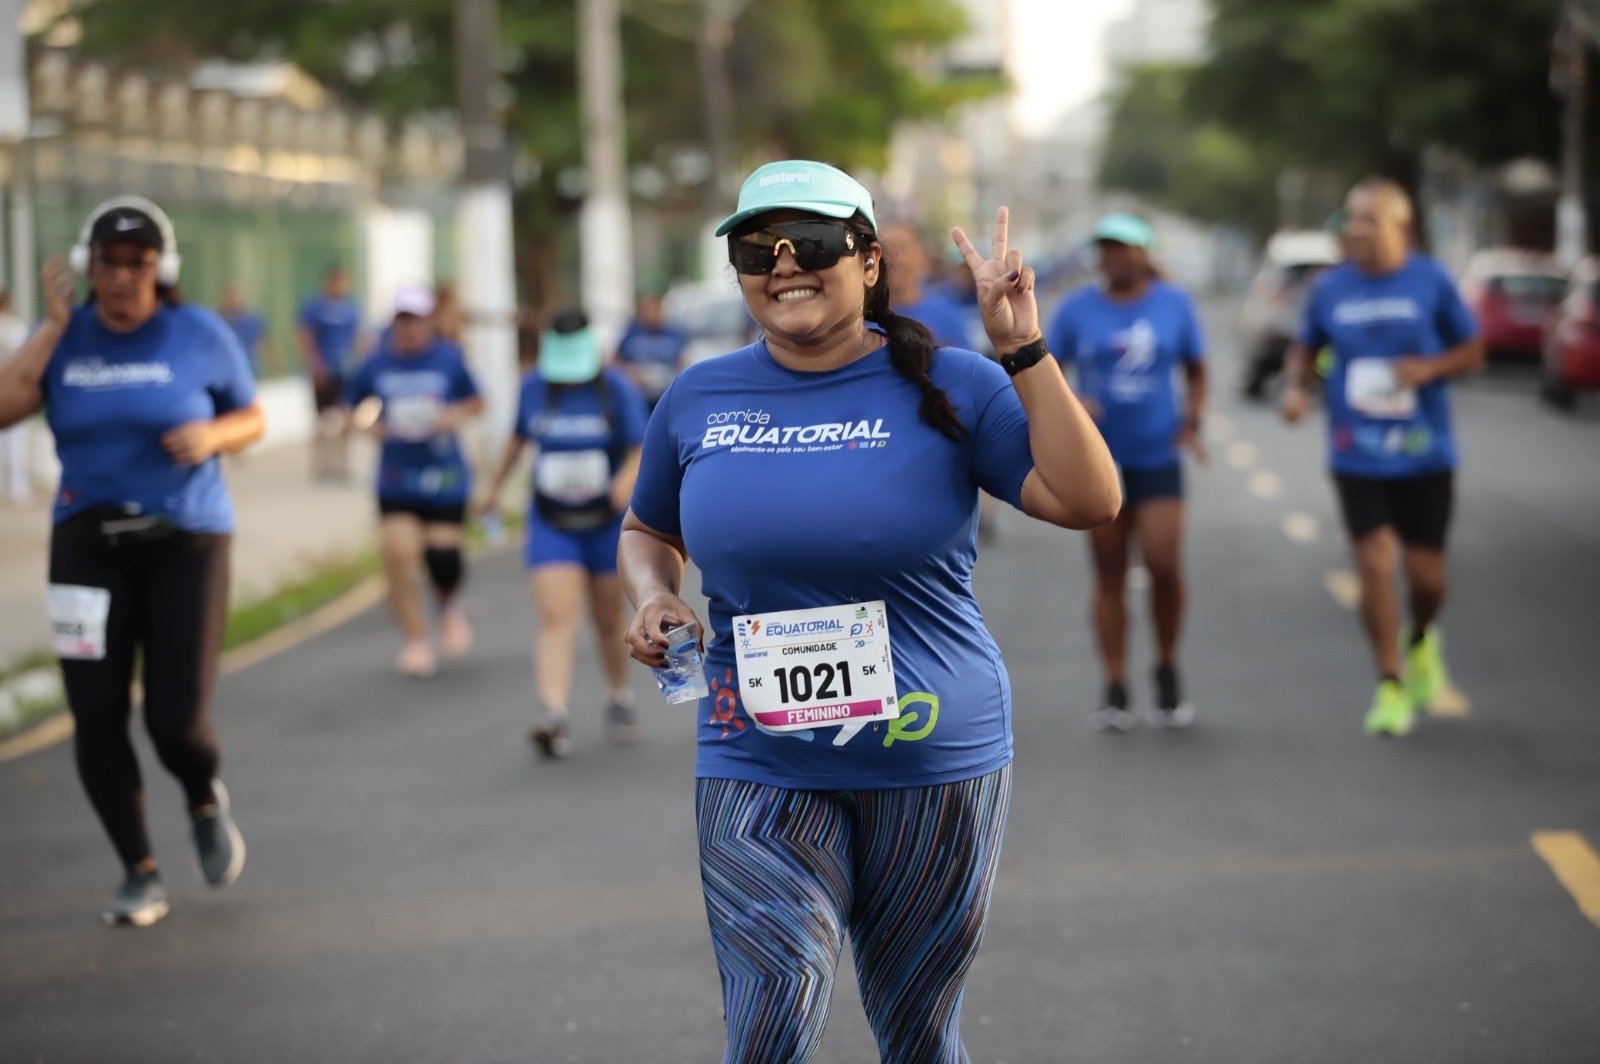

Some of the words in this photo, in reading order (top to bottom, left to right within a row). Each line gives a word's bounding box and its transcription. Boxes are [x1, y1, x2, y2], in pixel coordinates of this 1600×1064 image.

[707, 409, 771, 425] corrida
[702, 418, 891, 449] EQUATORIAL
[776, 445, 791, 454] pelo
[766, 619, 844, 637] EQUATORIAL
[782, 642, 837, 656] COMUNIDADE
[862, 664, 877, 676] 5K
[749, 677, 763, 688] 5K
[774, 661, 852, 704] 1021
[787, 705, 850, 724] FEMININO
